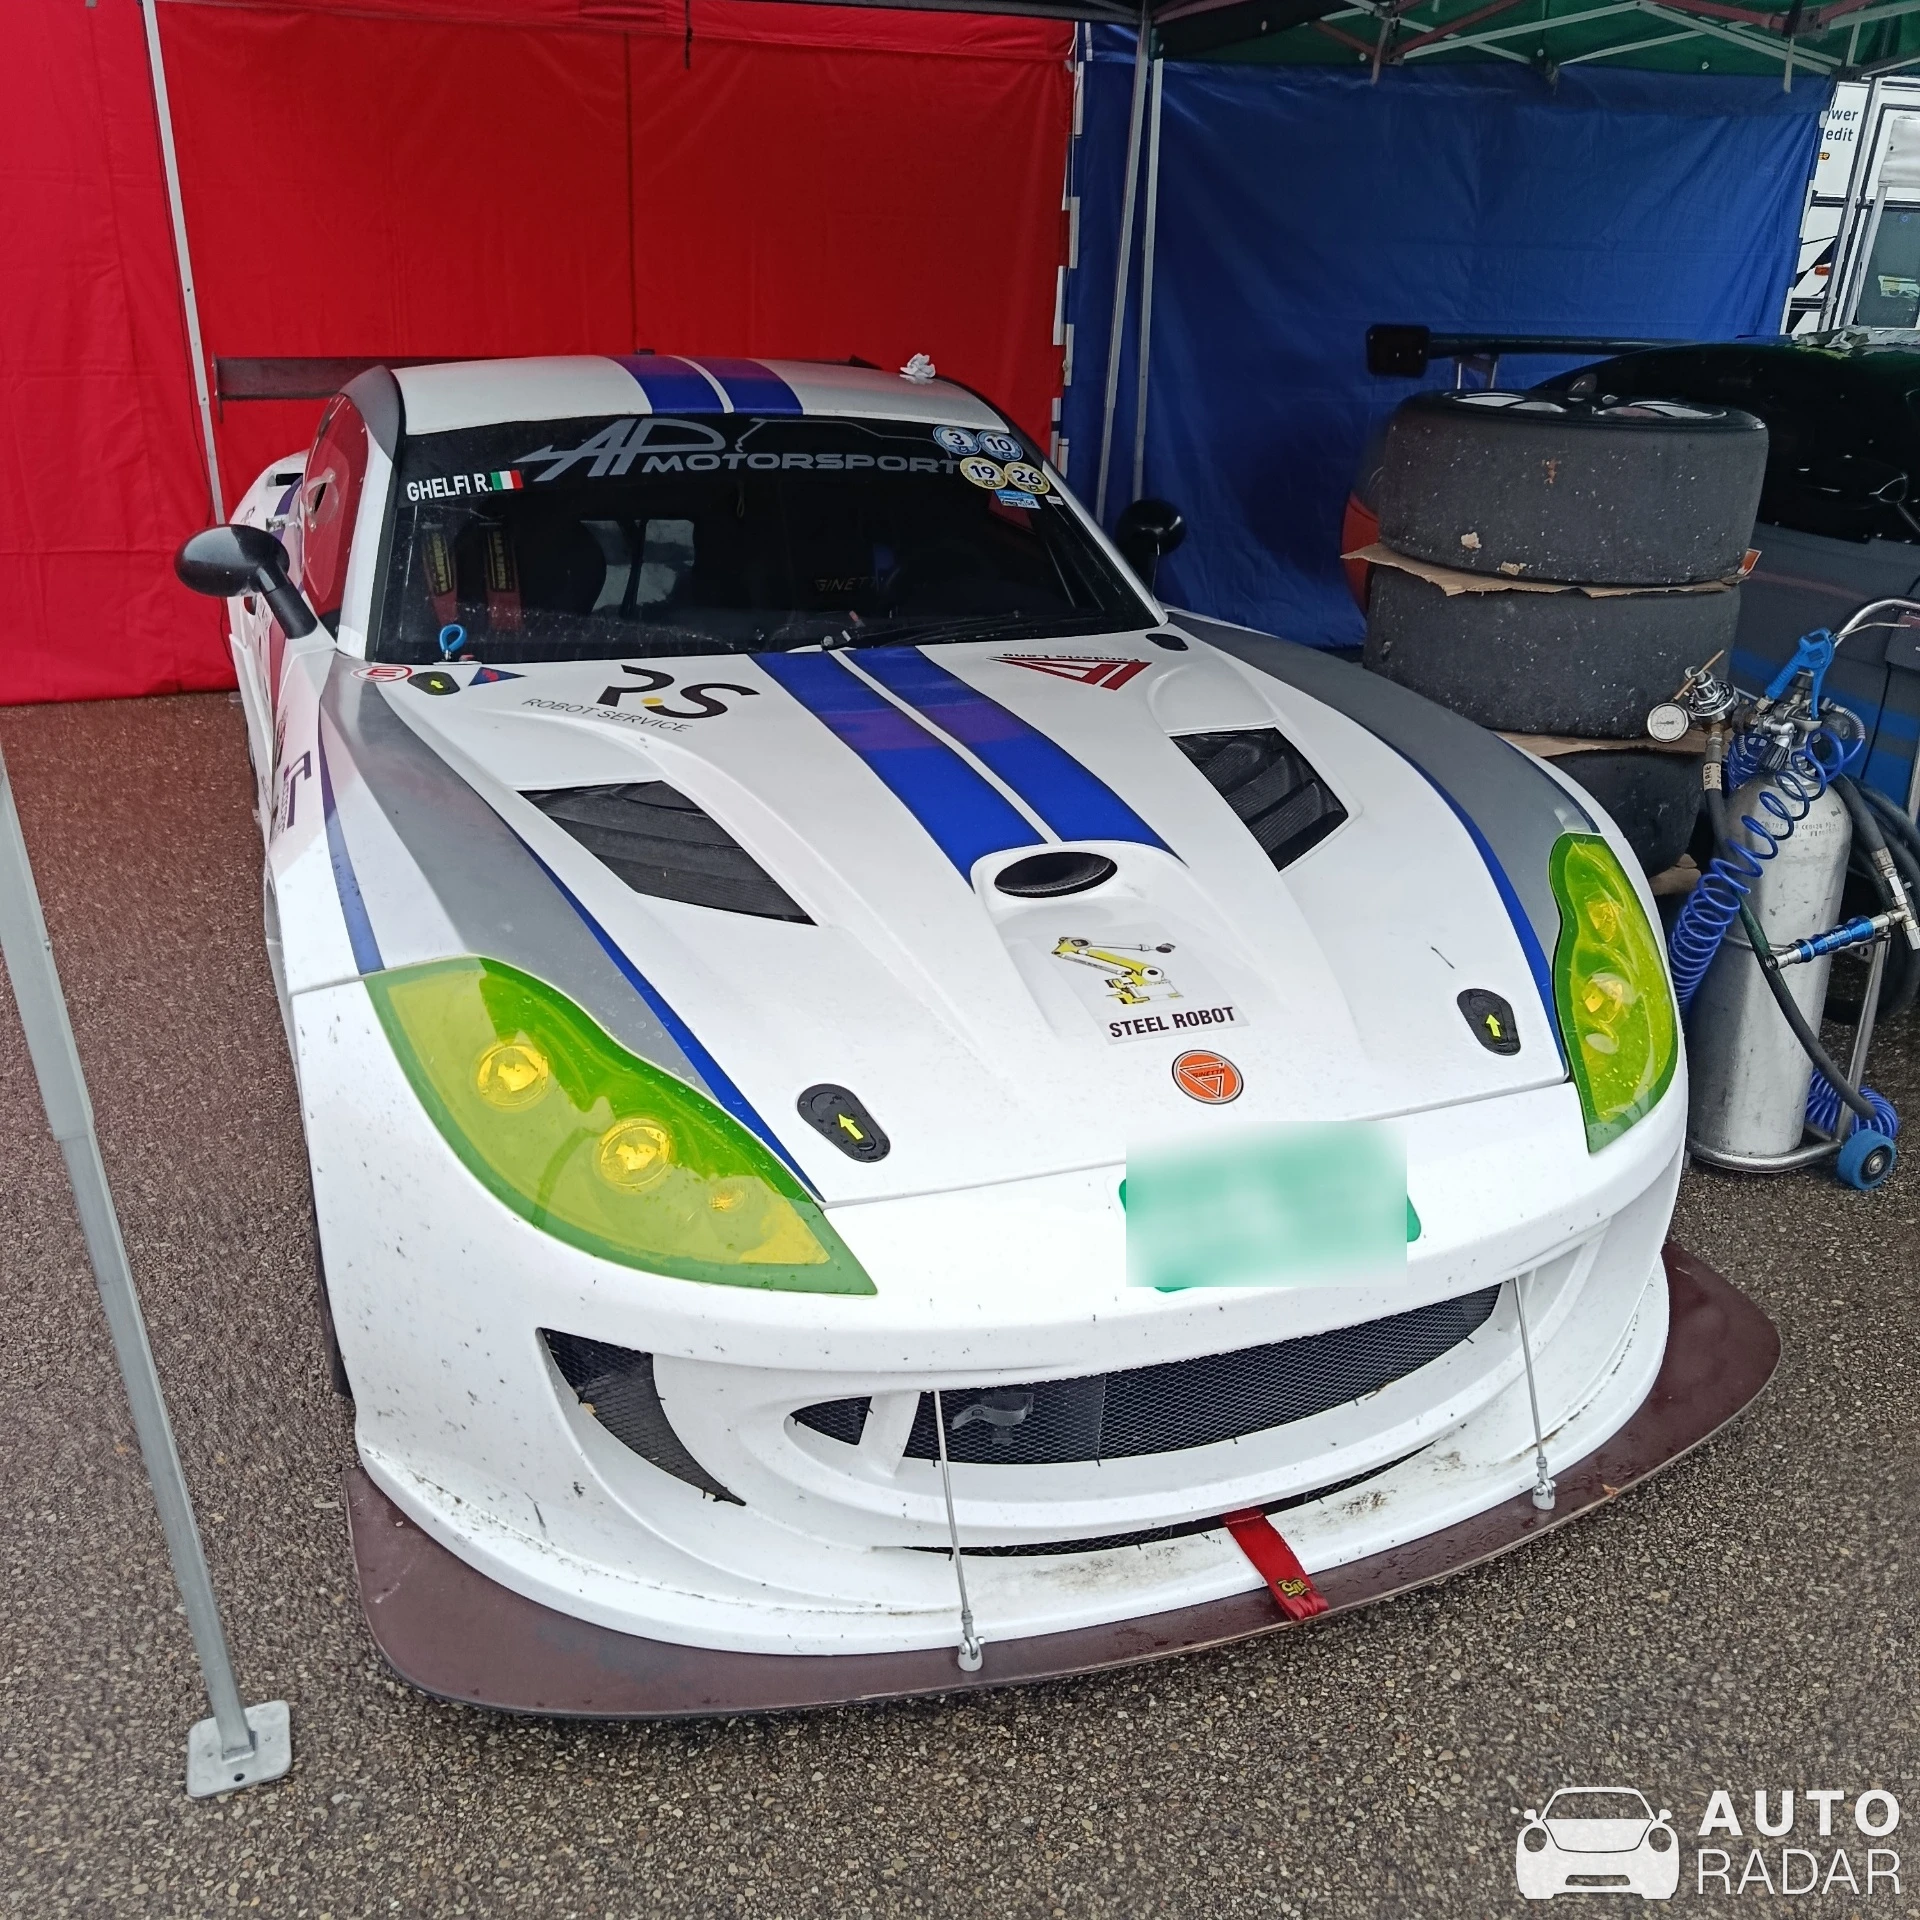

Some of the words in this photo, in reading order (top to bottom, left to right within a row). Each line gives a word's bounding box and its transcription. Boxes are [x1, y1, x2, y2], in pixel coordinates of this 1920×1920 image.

[948, 432, 965, 446] 3
[986, 437, 1012, 452] 10
[641, 453, 960, 474] MOTORSPORT
[970, 465, 996, 479] 19
[1012, 469, 1042, 485] 26
[406, 475, 471, 502] GHELFI
[473, 473, 493, 493] R.
[522, 698, 595, 714] ROBOT
[596, 709, 693, 733] SERVICE
[1109, 1016, 1169, 1037] STEEL
[1172, 1007, 1235, 1028] ROBOT
